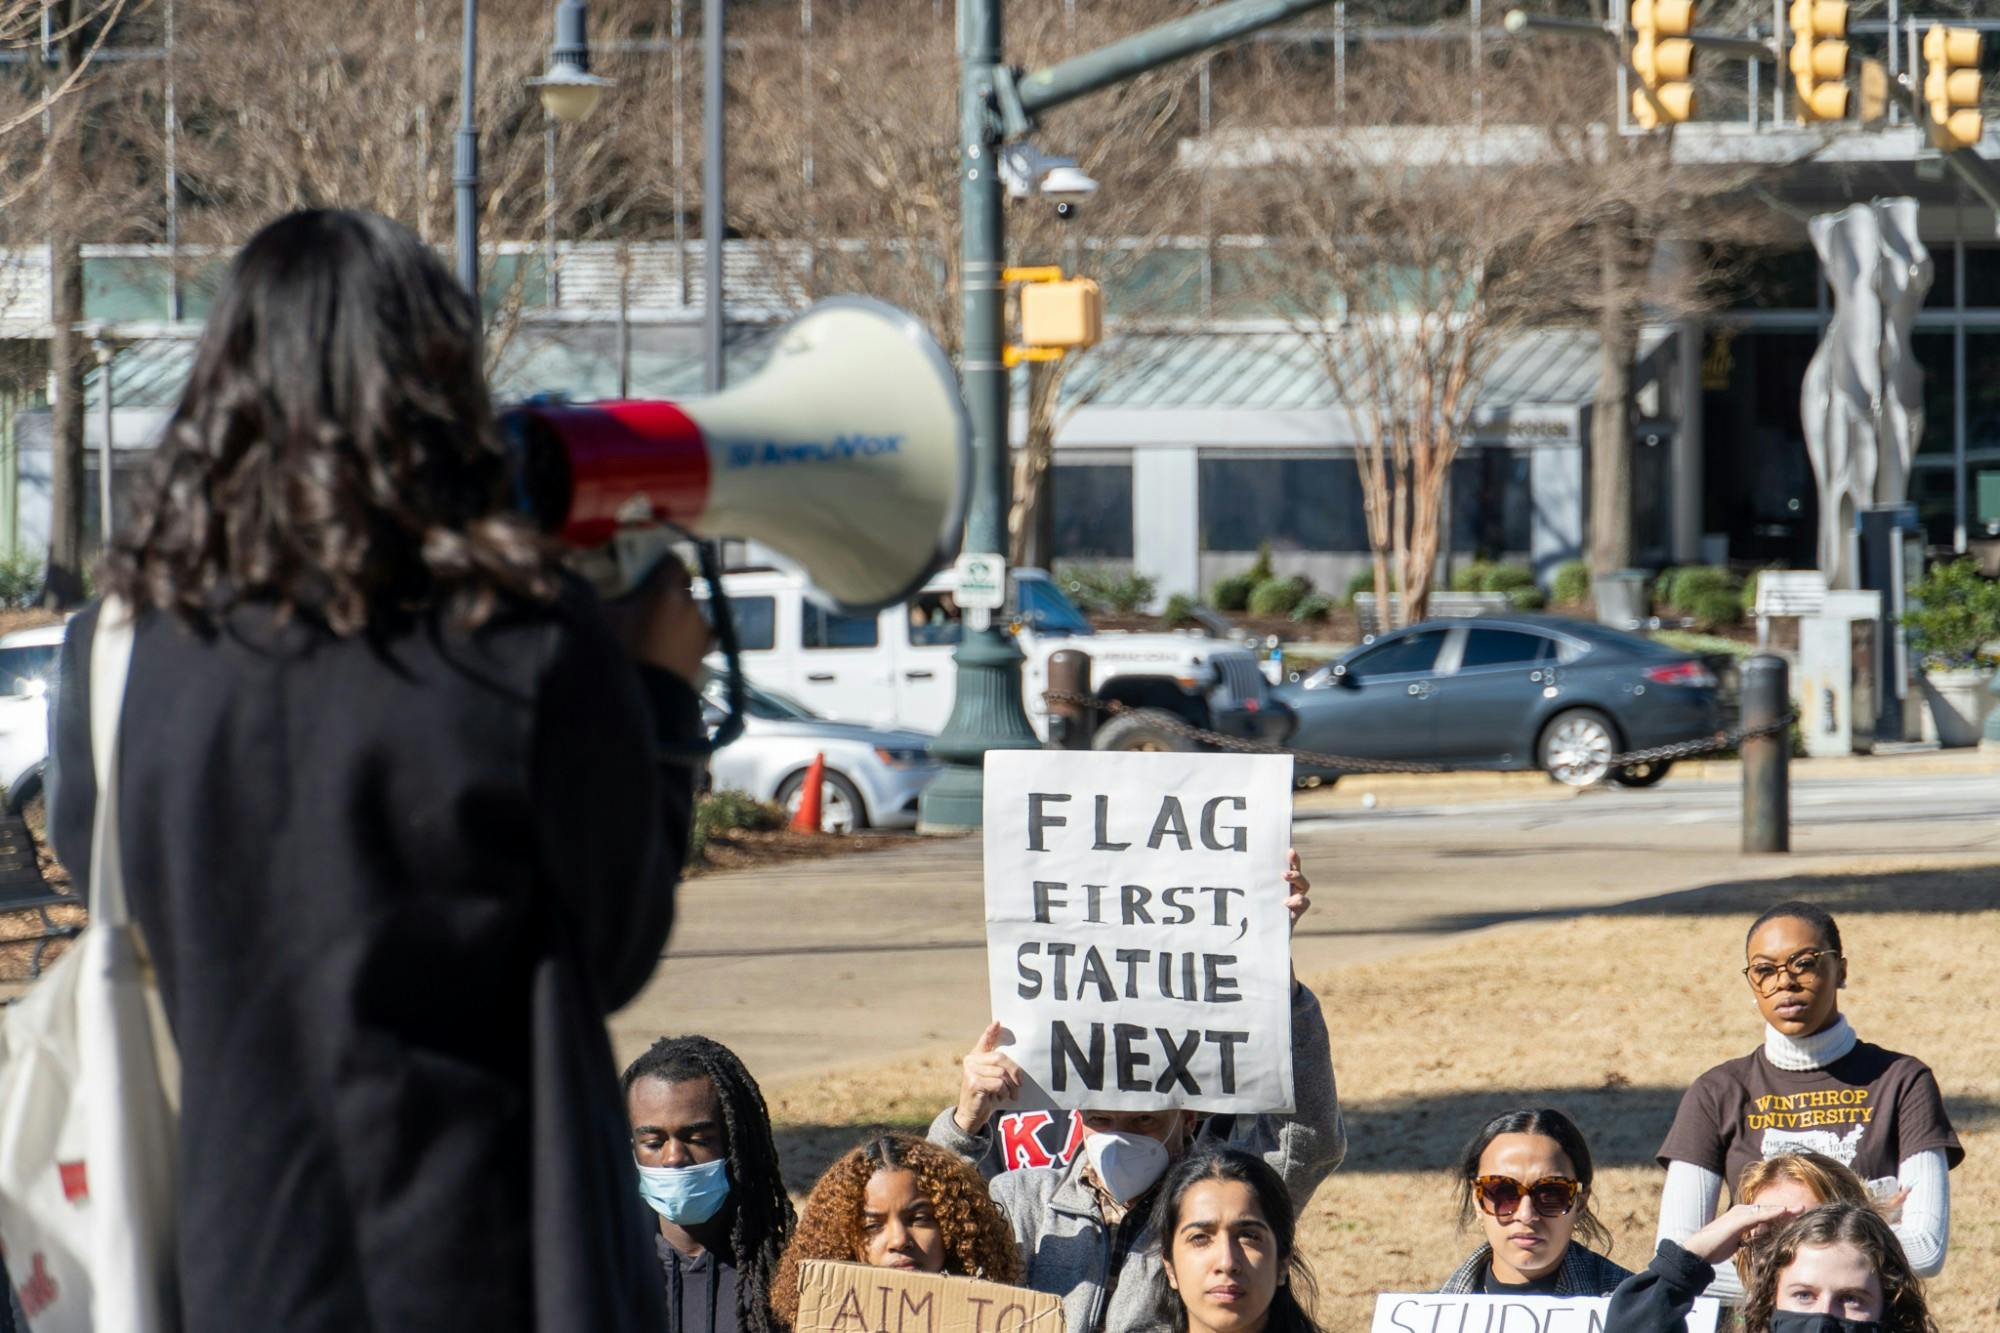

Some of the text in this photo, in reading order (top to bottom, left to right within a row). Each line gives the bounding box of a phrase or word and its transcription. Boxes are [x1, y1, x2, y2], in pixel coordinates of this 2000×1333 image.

[1025, 792, 1248, 853] FLAG
[1031, 880, 1249, 943] FIRST,
[1016, 941, 1243, 1003] STATUE
[1050, 1019, 1250, 1096] NEXT
[1747, 1106, 1874, 1130] UNIVERSITY
[1755, 1089, 1869, 1113] WINTHROP
[831, 1285, 1028, 1333] AIM TO
